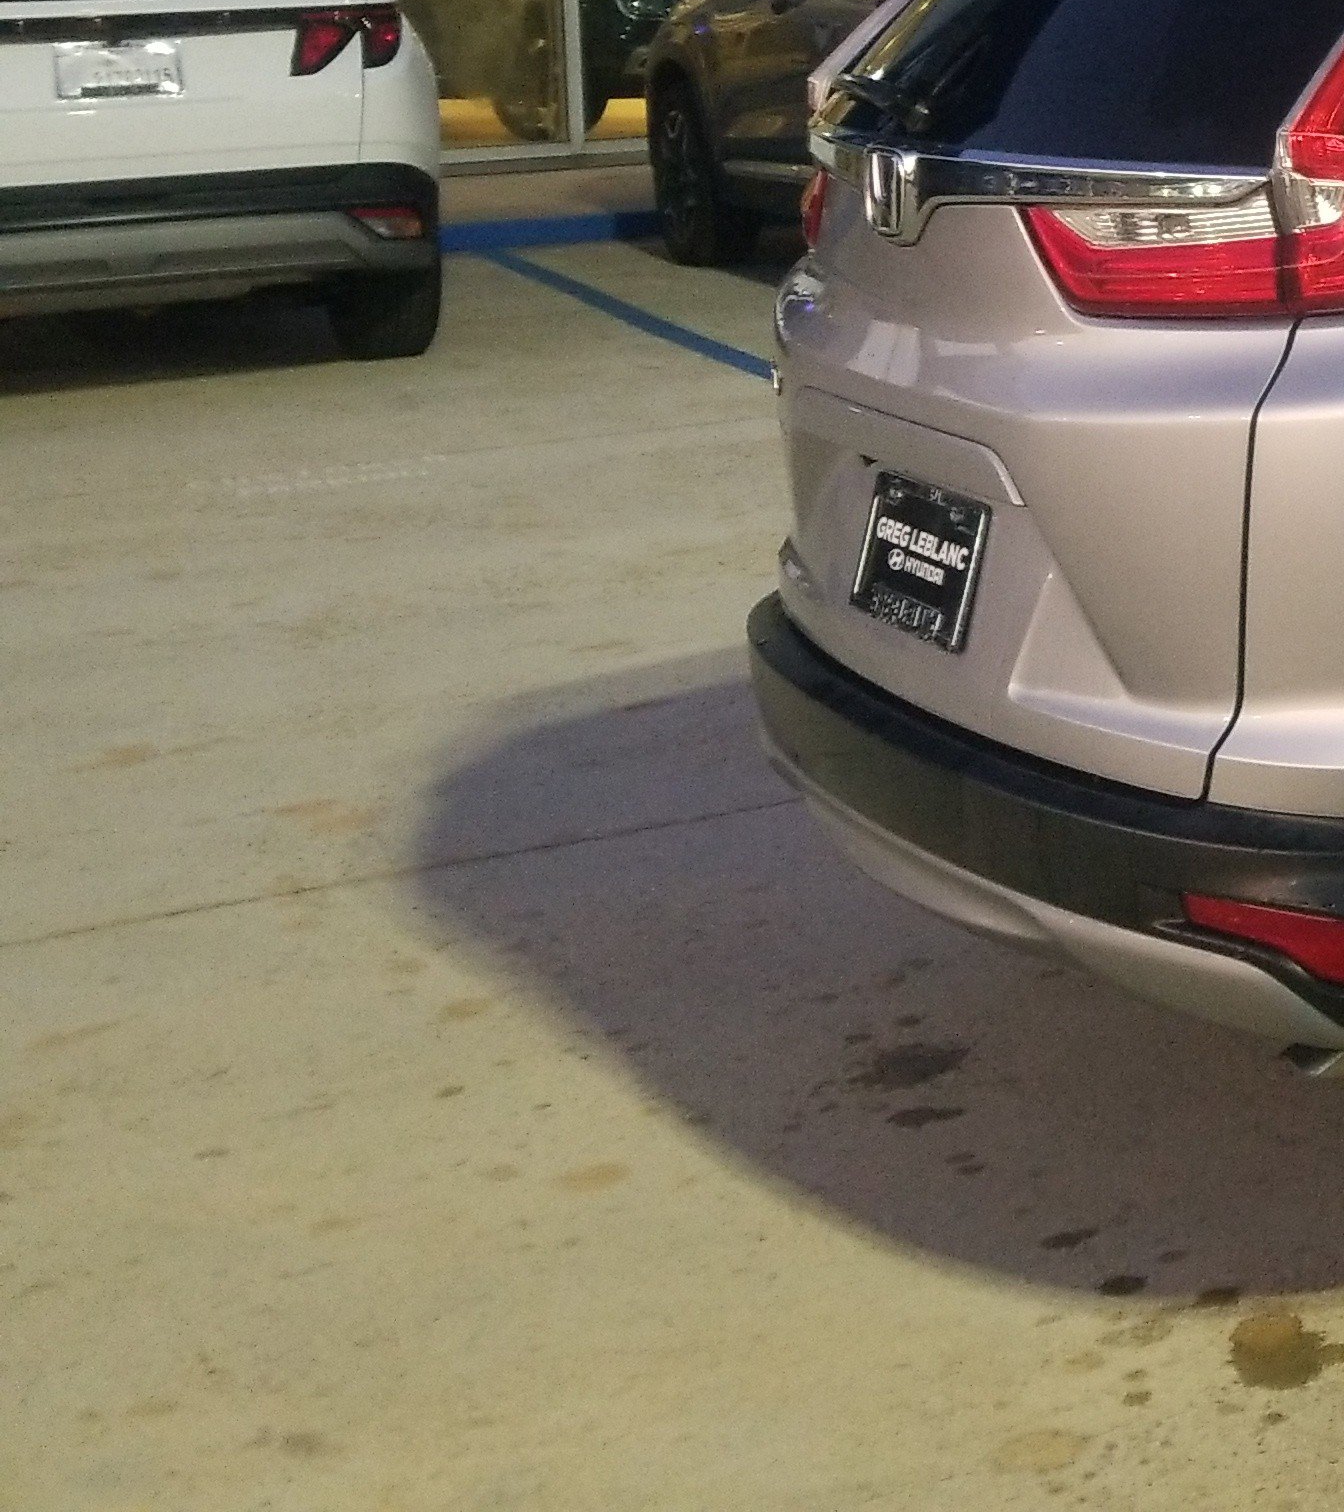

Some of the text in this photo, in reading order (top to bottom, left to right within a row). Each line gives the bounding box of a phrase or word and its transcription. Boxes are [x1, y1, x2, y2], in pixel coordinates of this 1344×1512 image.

[876, 516, 969, 570] GREG LEBLANC
[904, 556, 945, 586] HYUNDAI
